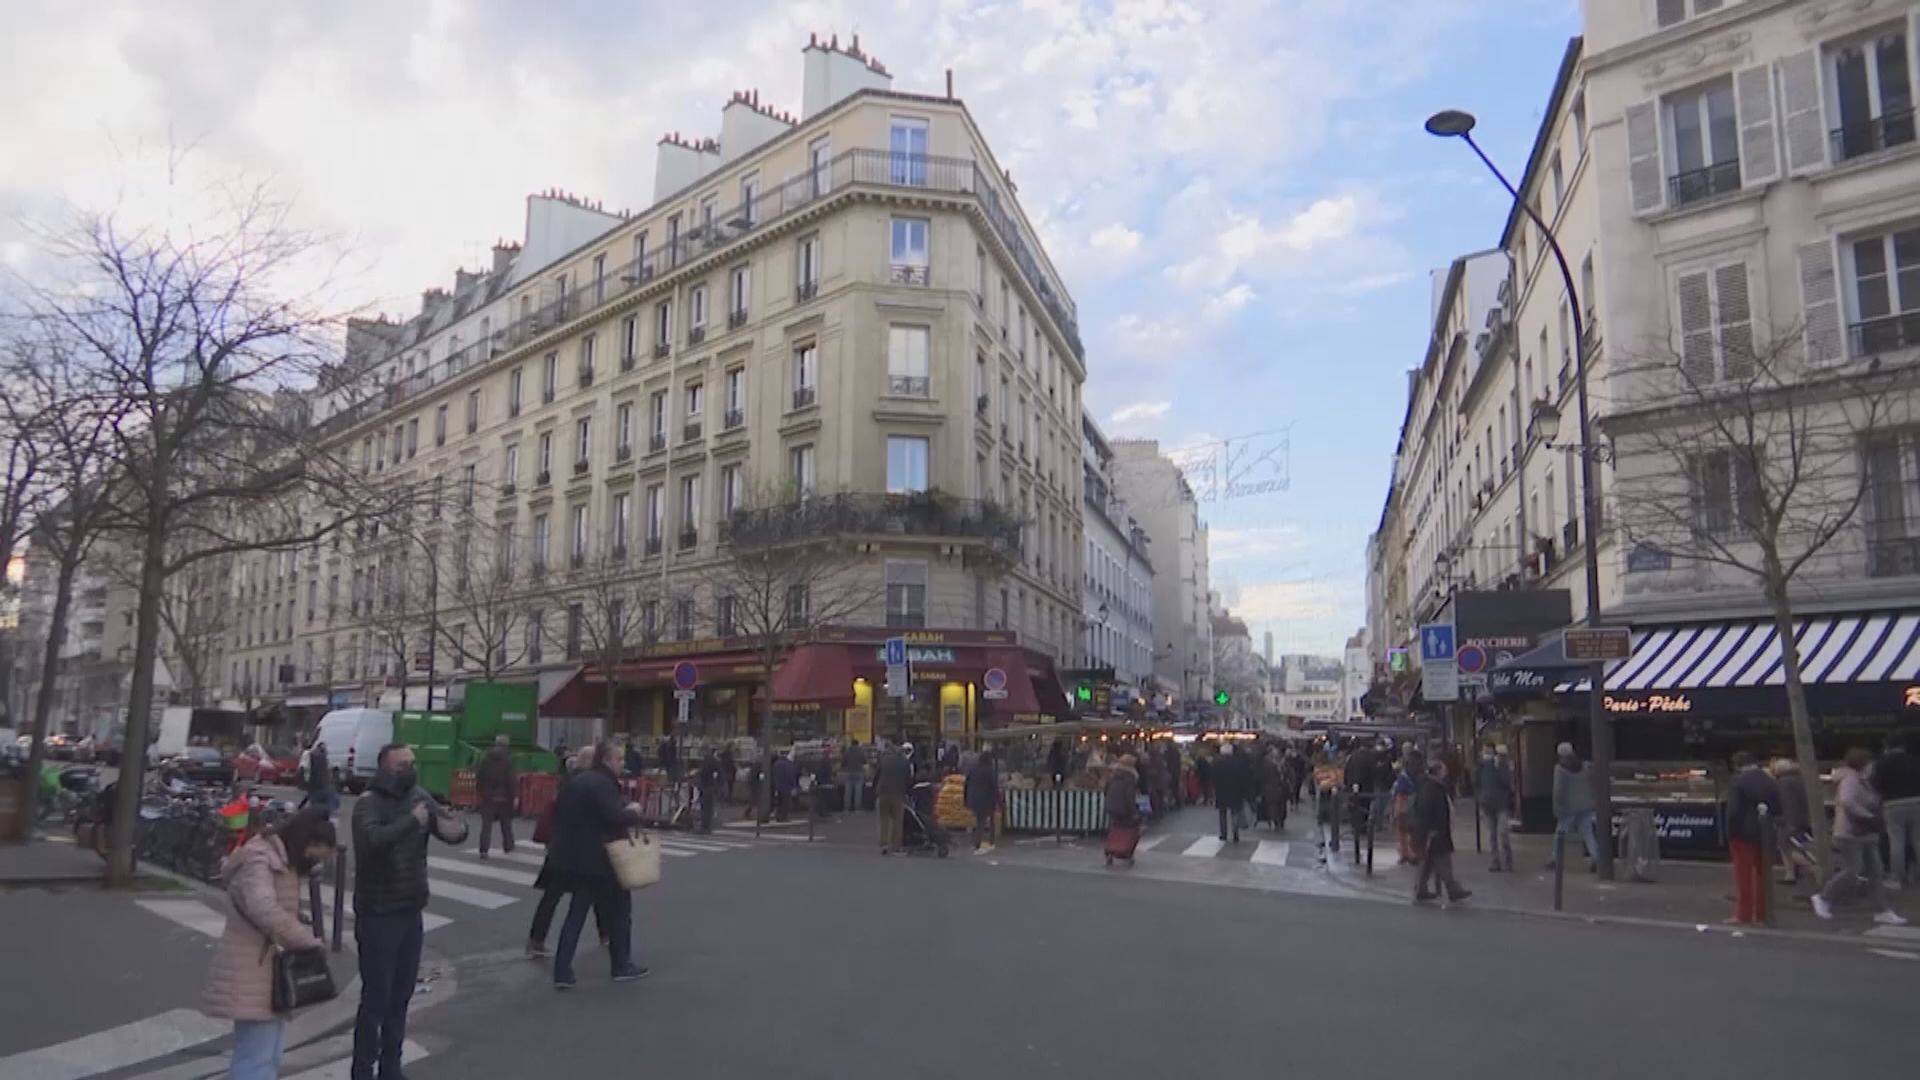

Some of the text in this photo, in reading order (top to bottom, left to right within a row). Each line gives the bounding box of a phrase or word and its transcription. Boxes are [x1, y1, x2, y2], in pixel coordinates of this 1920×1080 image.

[904, 632, 944, 642] SABAH
[1465, 637, 1527, 648] BOUCHERIE
[879, 649, 954, 662] SBAH
[1513, 669, 1545, 686] Mer
[1603, 694, 1692, 713] Paris-Pêche
[1665, 813, 1714, 828] poissons
[1669, 828, 1692, 838] mer
